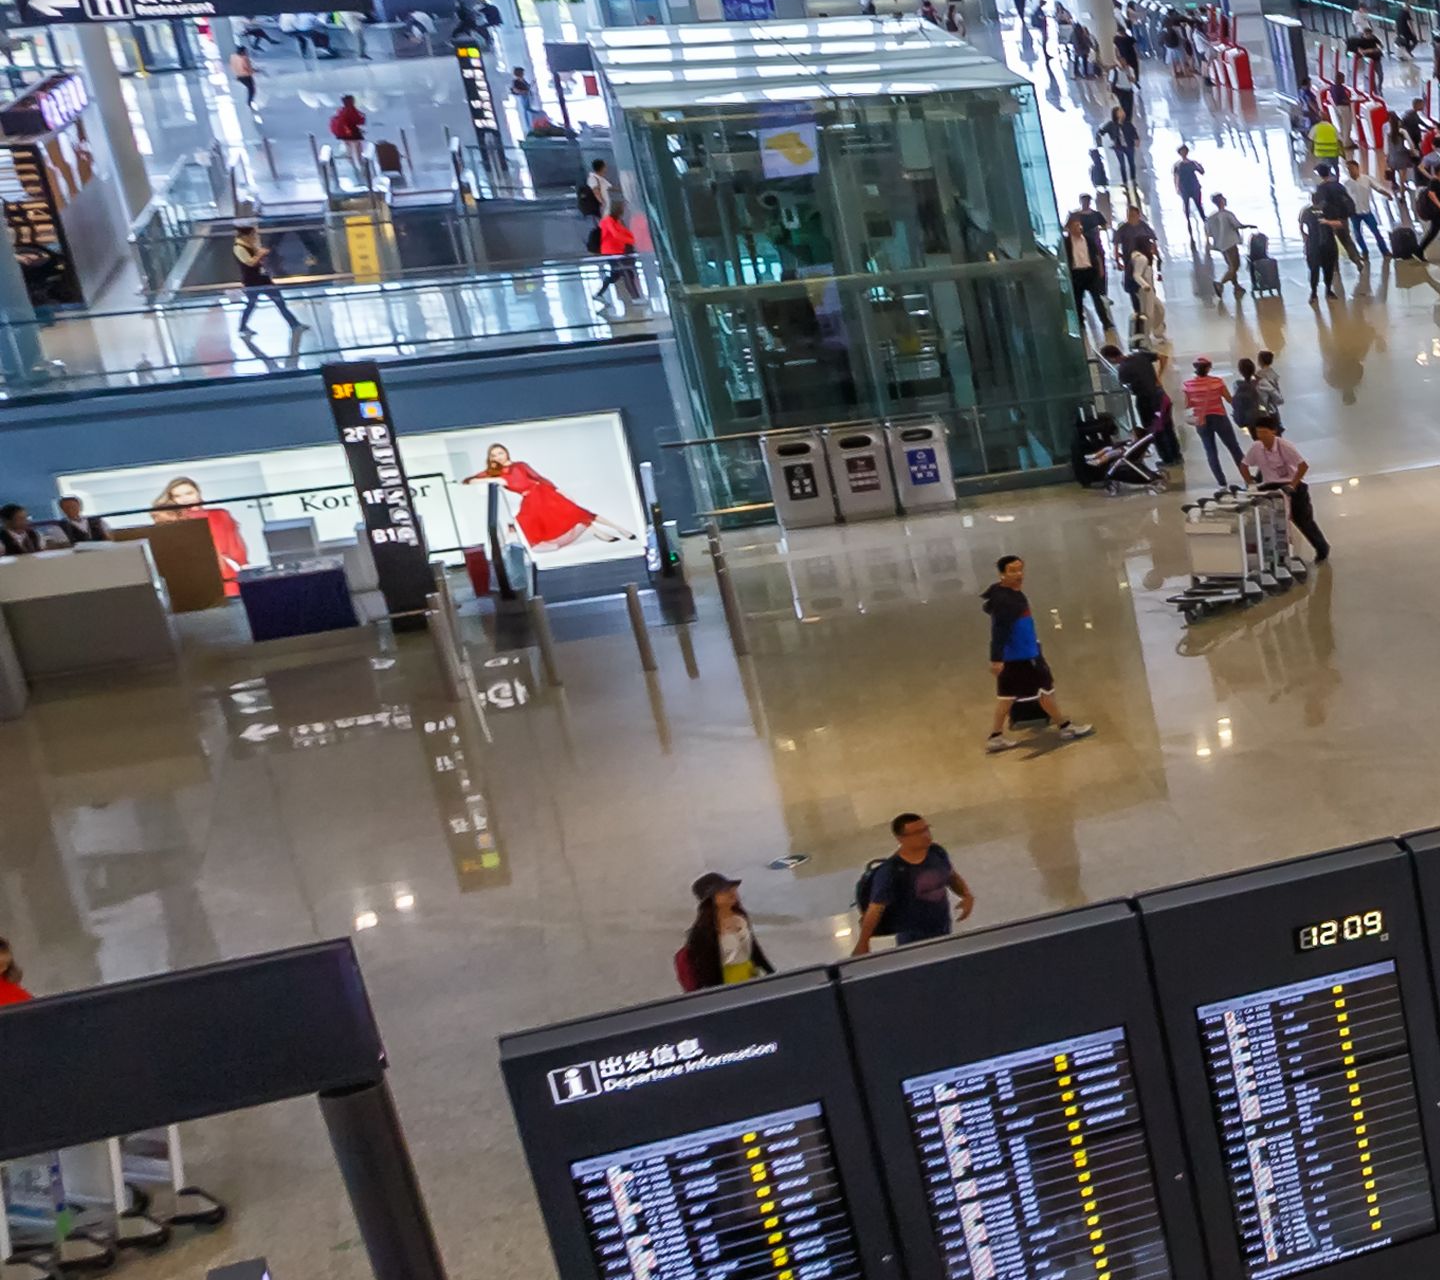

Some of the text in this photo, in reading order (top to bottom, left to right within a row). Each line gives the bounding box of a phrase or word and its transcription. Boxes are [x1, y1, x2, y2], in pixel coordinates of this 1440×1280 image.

[331, 383, 354, 399] 3F
[343, 426, 367, 442] 2F
[363, 489, 385, 504] 1F
[599, 1037, 704, 1078] 出发信息
[603, 1064, 685, 1093] Departure
